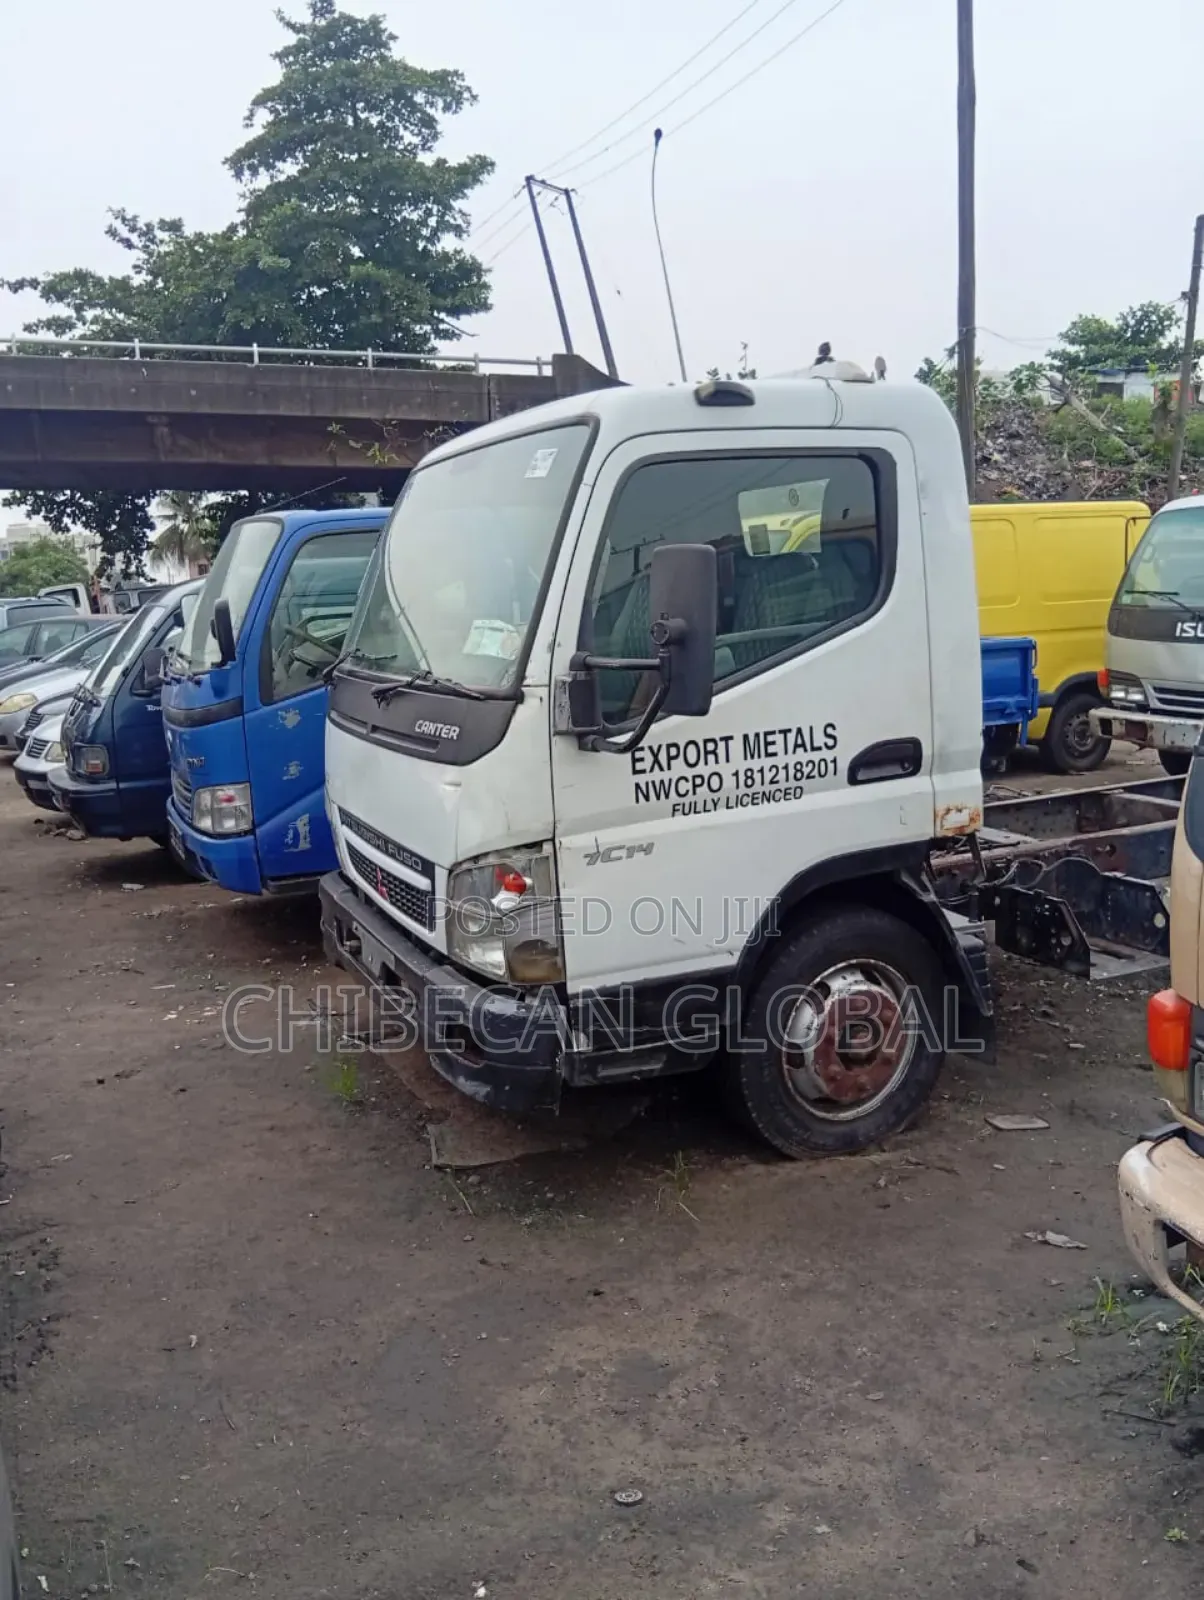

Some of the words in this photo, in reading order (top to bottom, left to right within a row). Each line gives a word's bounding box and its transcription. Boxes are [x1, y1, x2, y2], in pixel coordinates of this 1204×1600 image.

[414, 719, 460, 740] CANTER
[630, 735, 734, 775] EXPORT
[742, 722, 838, 761] METALS
[634, 771, 723, 804] NWCPO
[731, 756, 838, 792] 181218201
[671, 797, 721, 818] FULLY
[725, 785, 804, 811] LICENCED
[388, 843, 422, 871] FUSO
